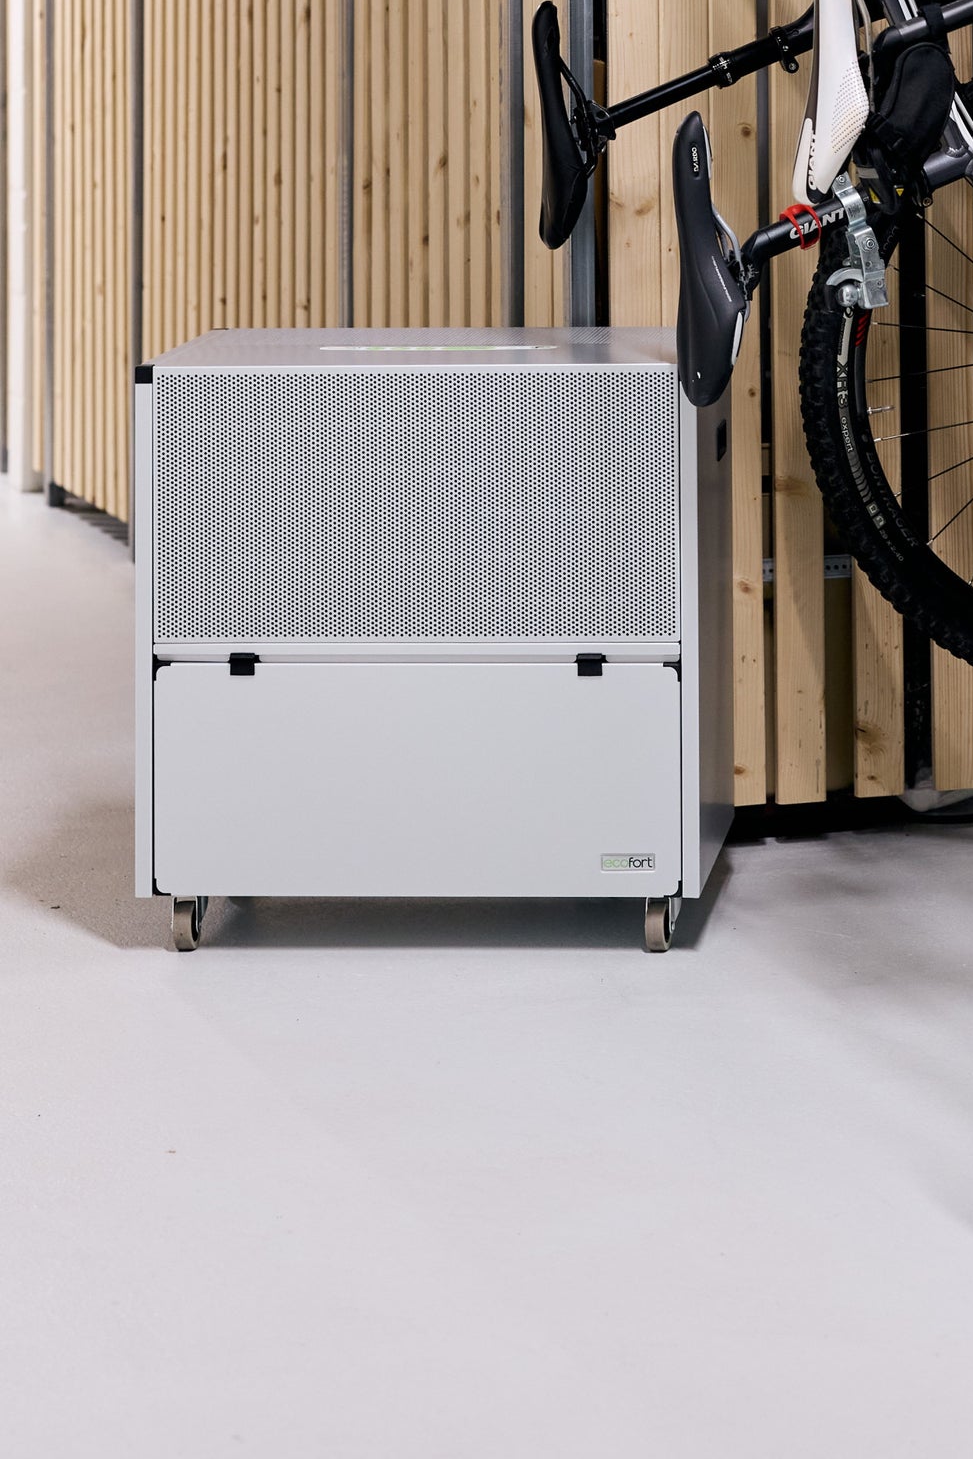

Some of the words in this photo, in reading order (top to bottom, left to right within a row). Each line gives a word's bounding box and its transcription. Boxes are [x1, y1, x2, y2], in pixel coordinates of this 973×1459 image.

[789, 207, 845, 239] GIANT
[841, 416, 854, 453] expert
[603, 856, 654, 869] ecofort
